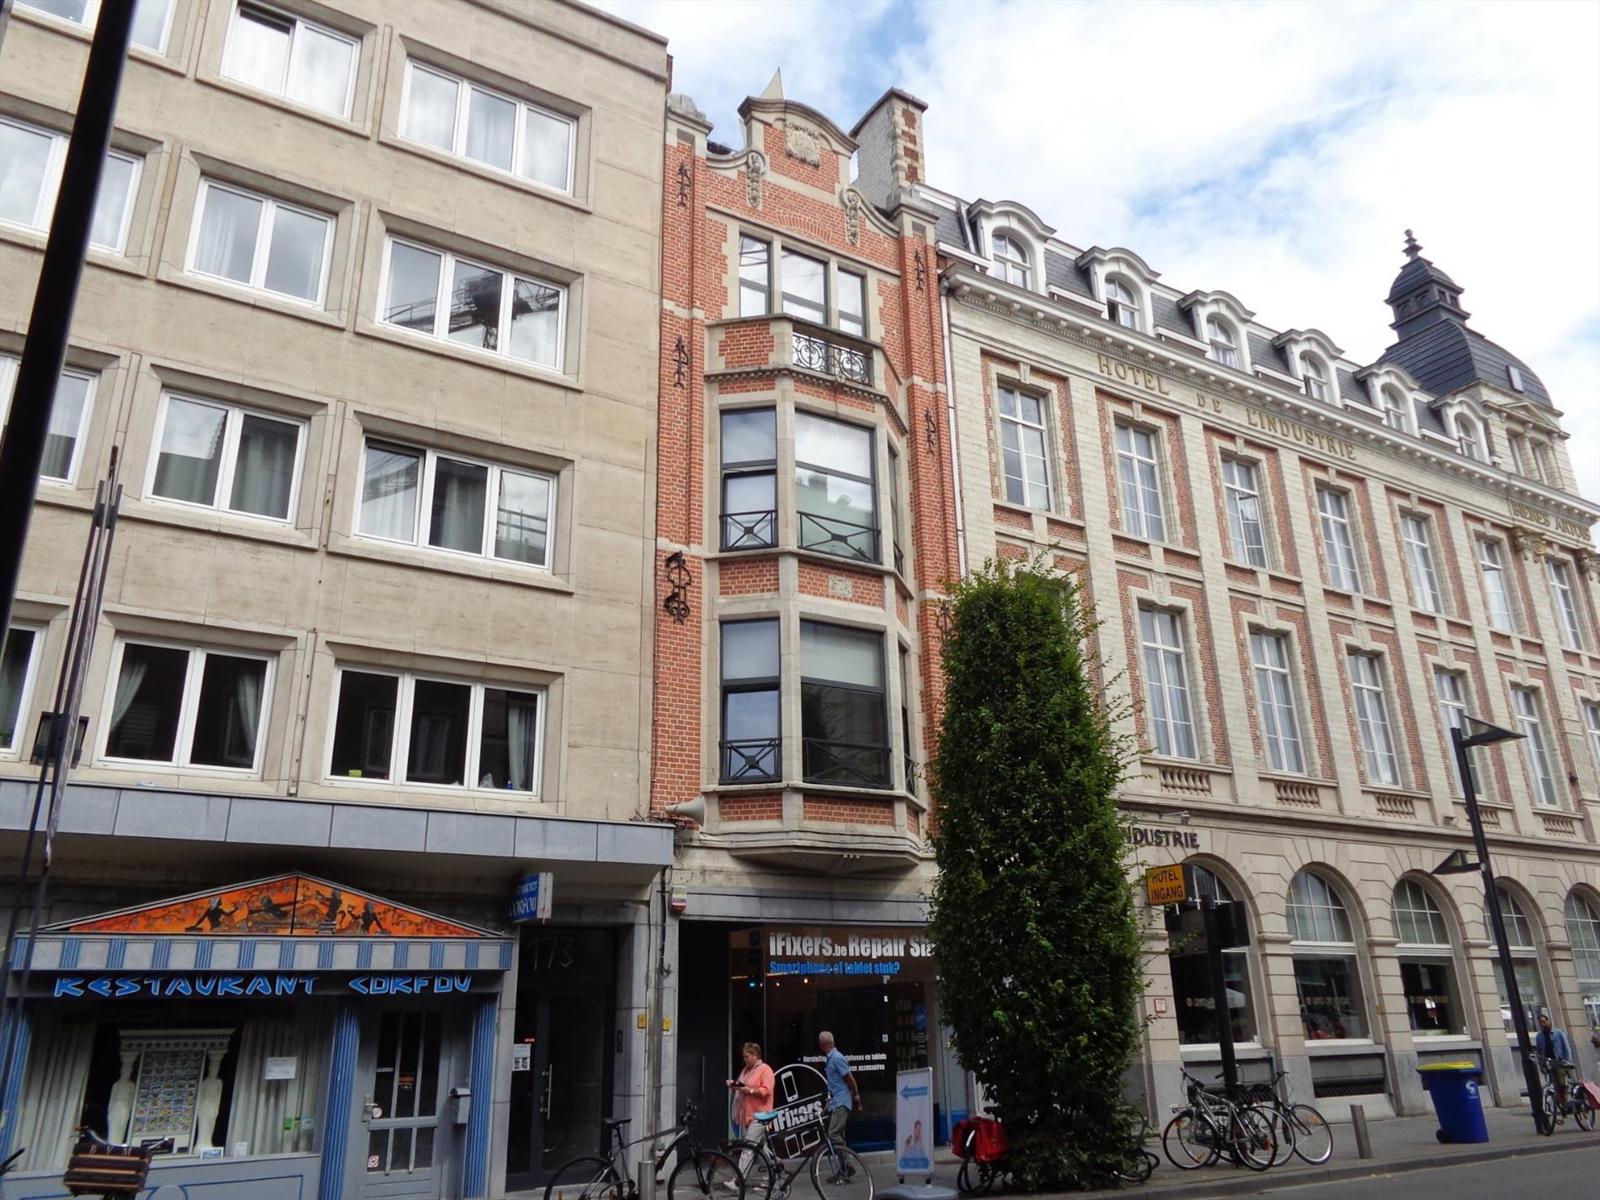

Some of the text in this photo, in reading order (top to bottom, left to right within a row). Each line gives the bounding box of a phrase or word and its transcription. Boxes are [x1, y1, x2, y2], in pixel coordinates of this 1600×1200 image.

[1097, 354, 1358, 461] HOTEL DE L'INDUSTRIE
[1122, 825, 1200, 849] NDUSTRIE
[1151, 870, 1179, 883] HOTEL
[1151, 884, 1184, 901] INGANG
[847, 933, 906, 959] Repair
[53, 975, 320, 998] RESTAURANT
